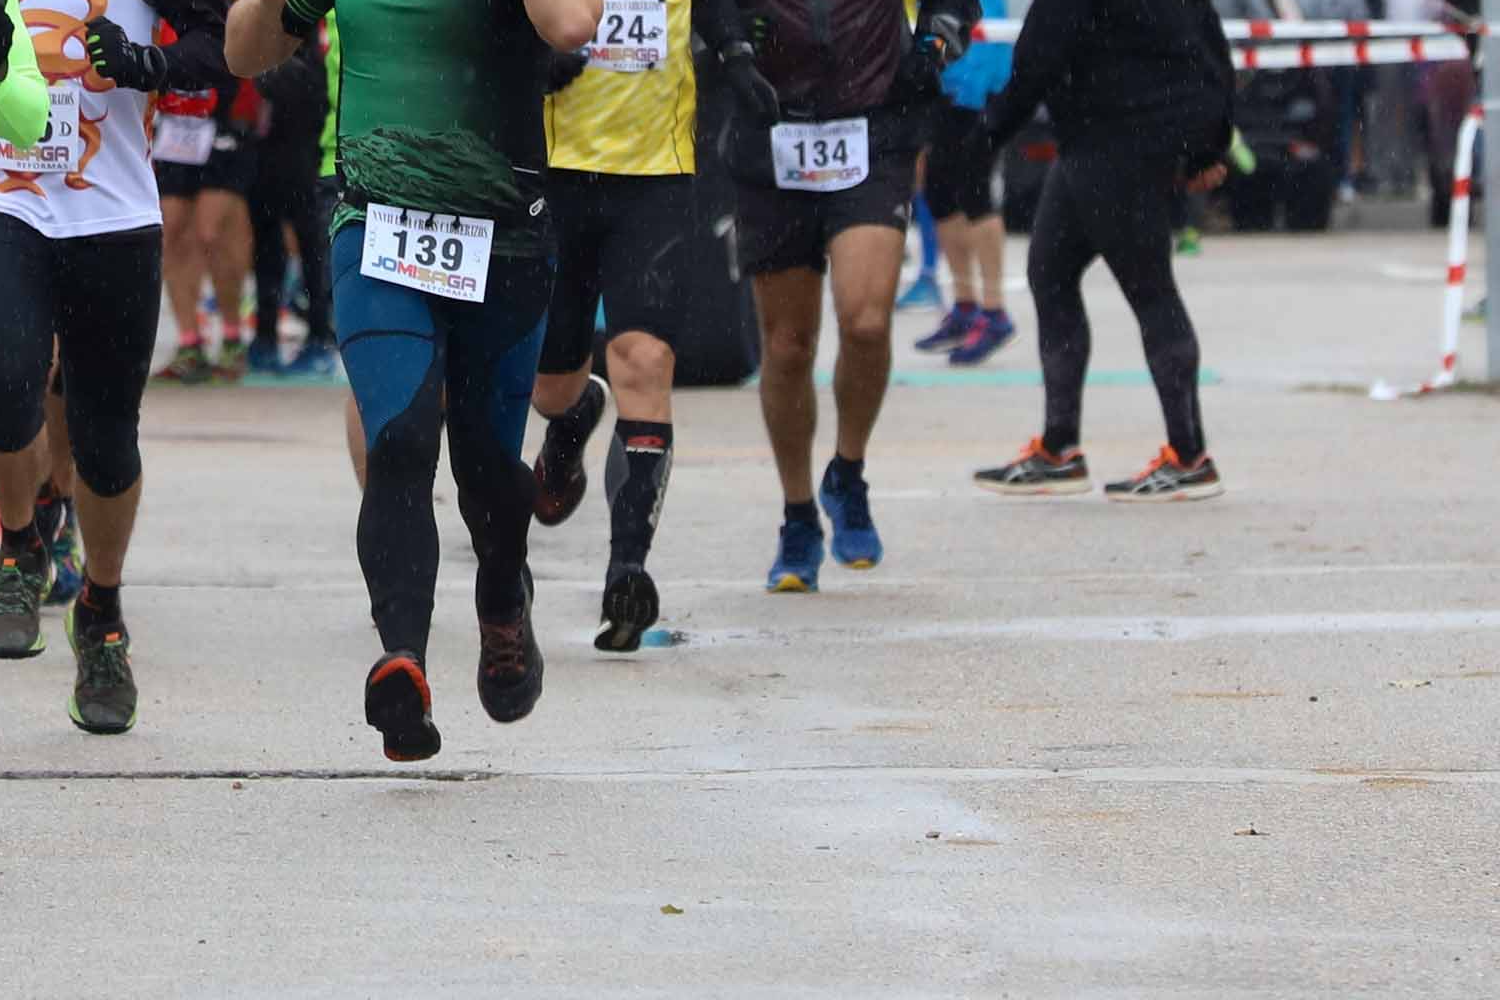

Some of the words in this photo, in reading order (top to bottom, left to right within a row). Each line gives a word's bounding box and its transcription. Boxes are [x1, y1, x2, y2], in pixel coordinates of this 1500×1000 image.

[793, 139, 848, 168] 134
[392, 230, 464, 272] 139
[371, 255, 477, 292] JOMISAGA
